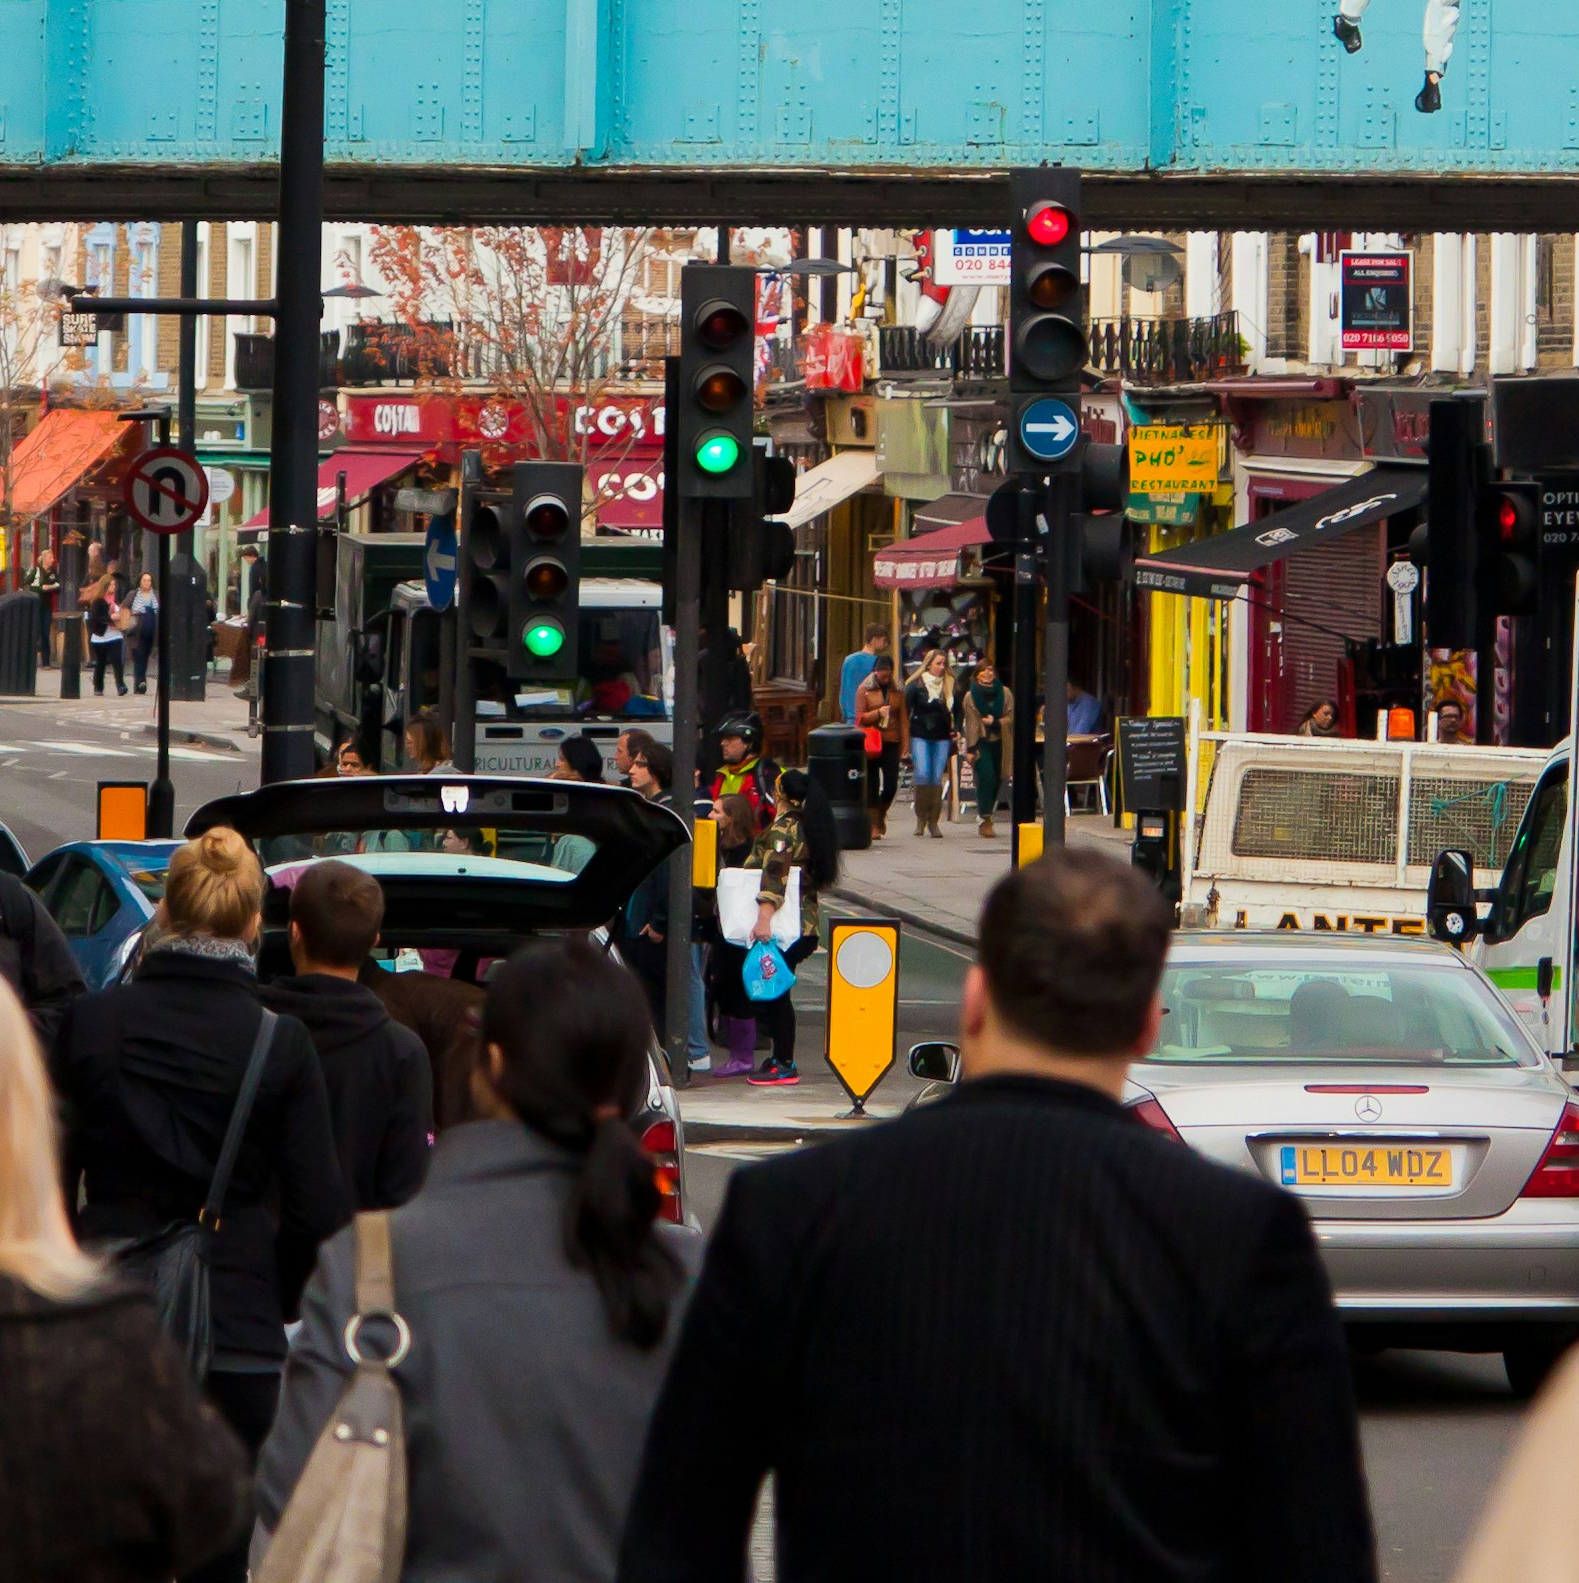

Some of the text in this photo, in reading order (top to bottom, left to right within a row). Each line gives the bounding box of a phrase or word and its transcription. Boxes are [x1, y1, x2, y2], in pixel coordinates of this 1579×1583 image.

[955, 259, 983, 271] 020
[1343, 333, 1360, 343] 020
[374, 404, 420, 436] COSTA
[1131, 480, 1216, 490] RESTAURANT
[1543, 532, 1567, 543] 020
[1302, 1150, 1443, 1178] LL04 WDZ
